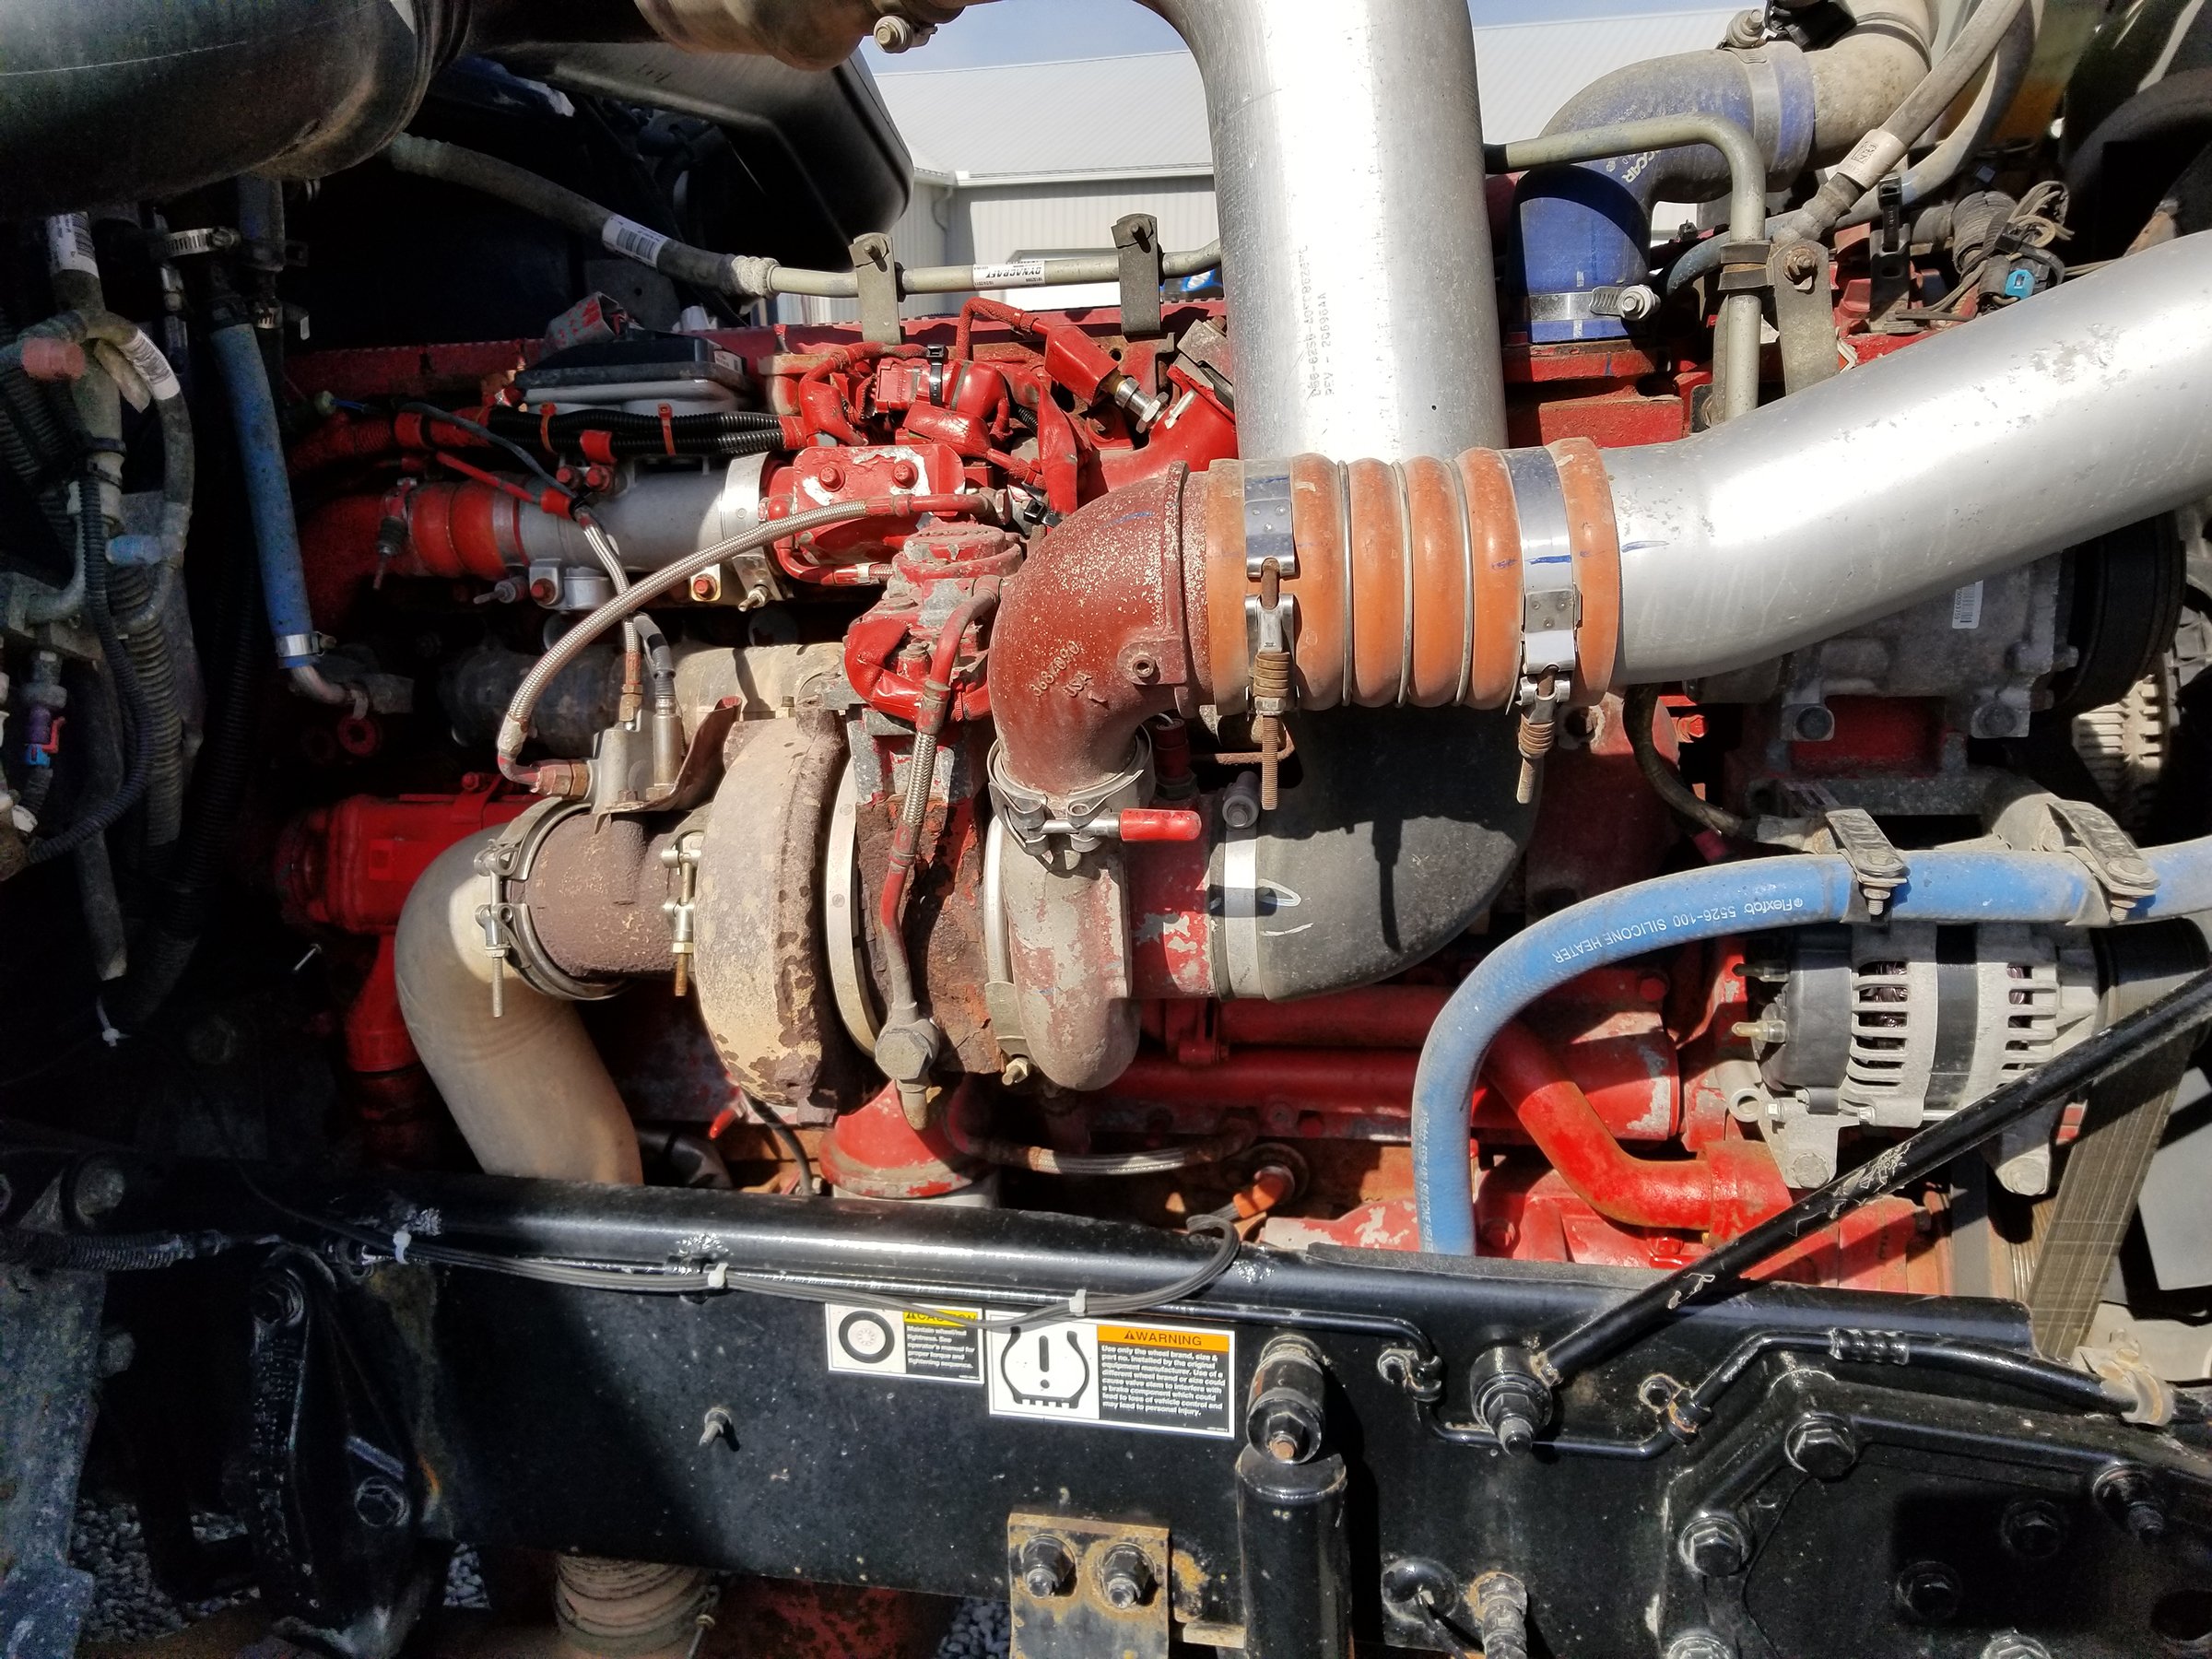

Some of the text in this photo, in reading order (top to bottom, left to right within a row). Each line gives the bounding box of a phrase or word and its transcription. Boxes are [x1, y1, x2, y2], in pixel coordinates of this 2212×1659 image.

[1621, 150, 1661, 182] CCAR
[985, 267, 1041, 278] DYNACRAFT
[1063, 670, 1093, 698] USA
[1551, 898, 1793, 964] Flexfab 5526-100 SILICONE HEATER
[1136, 1331, 1202, 1346] WARNING
[930, 1351, 951, 1359] torque
[1117, 1347, 1134, 1355] only
[1171, 1351, 1194, 1359] brand,
[1195, 1353, 1210, 1361] size
[908, 1358, 940, 1367] tightening
[1101, 1362, 1140, 1371] equipment
[1187, 1361, 1215, 1370] original
[1156, 1373, 1178, 1382] brand
[1174, 1383, 1205, 1392] interfere
[1130, 1388, 1171, 1397] component
[1154, 1397, 1180, 1406] vehicle
[1102, 1401, 1119, 1409] may
[1178, 1407, 1202, 1417] injury.
